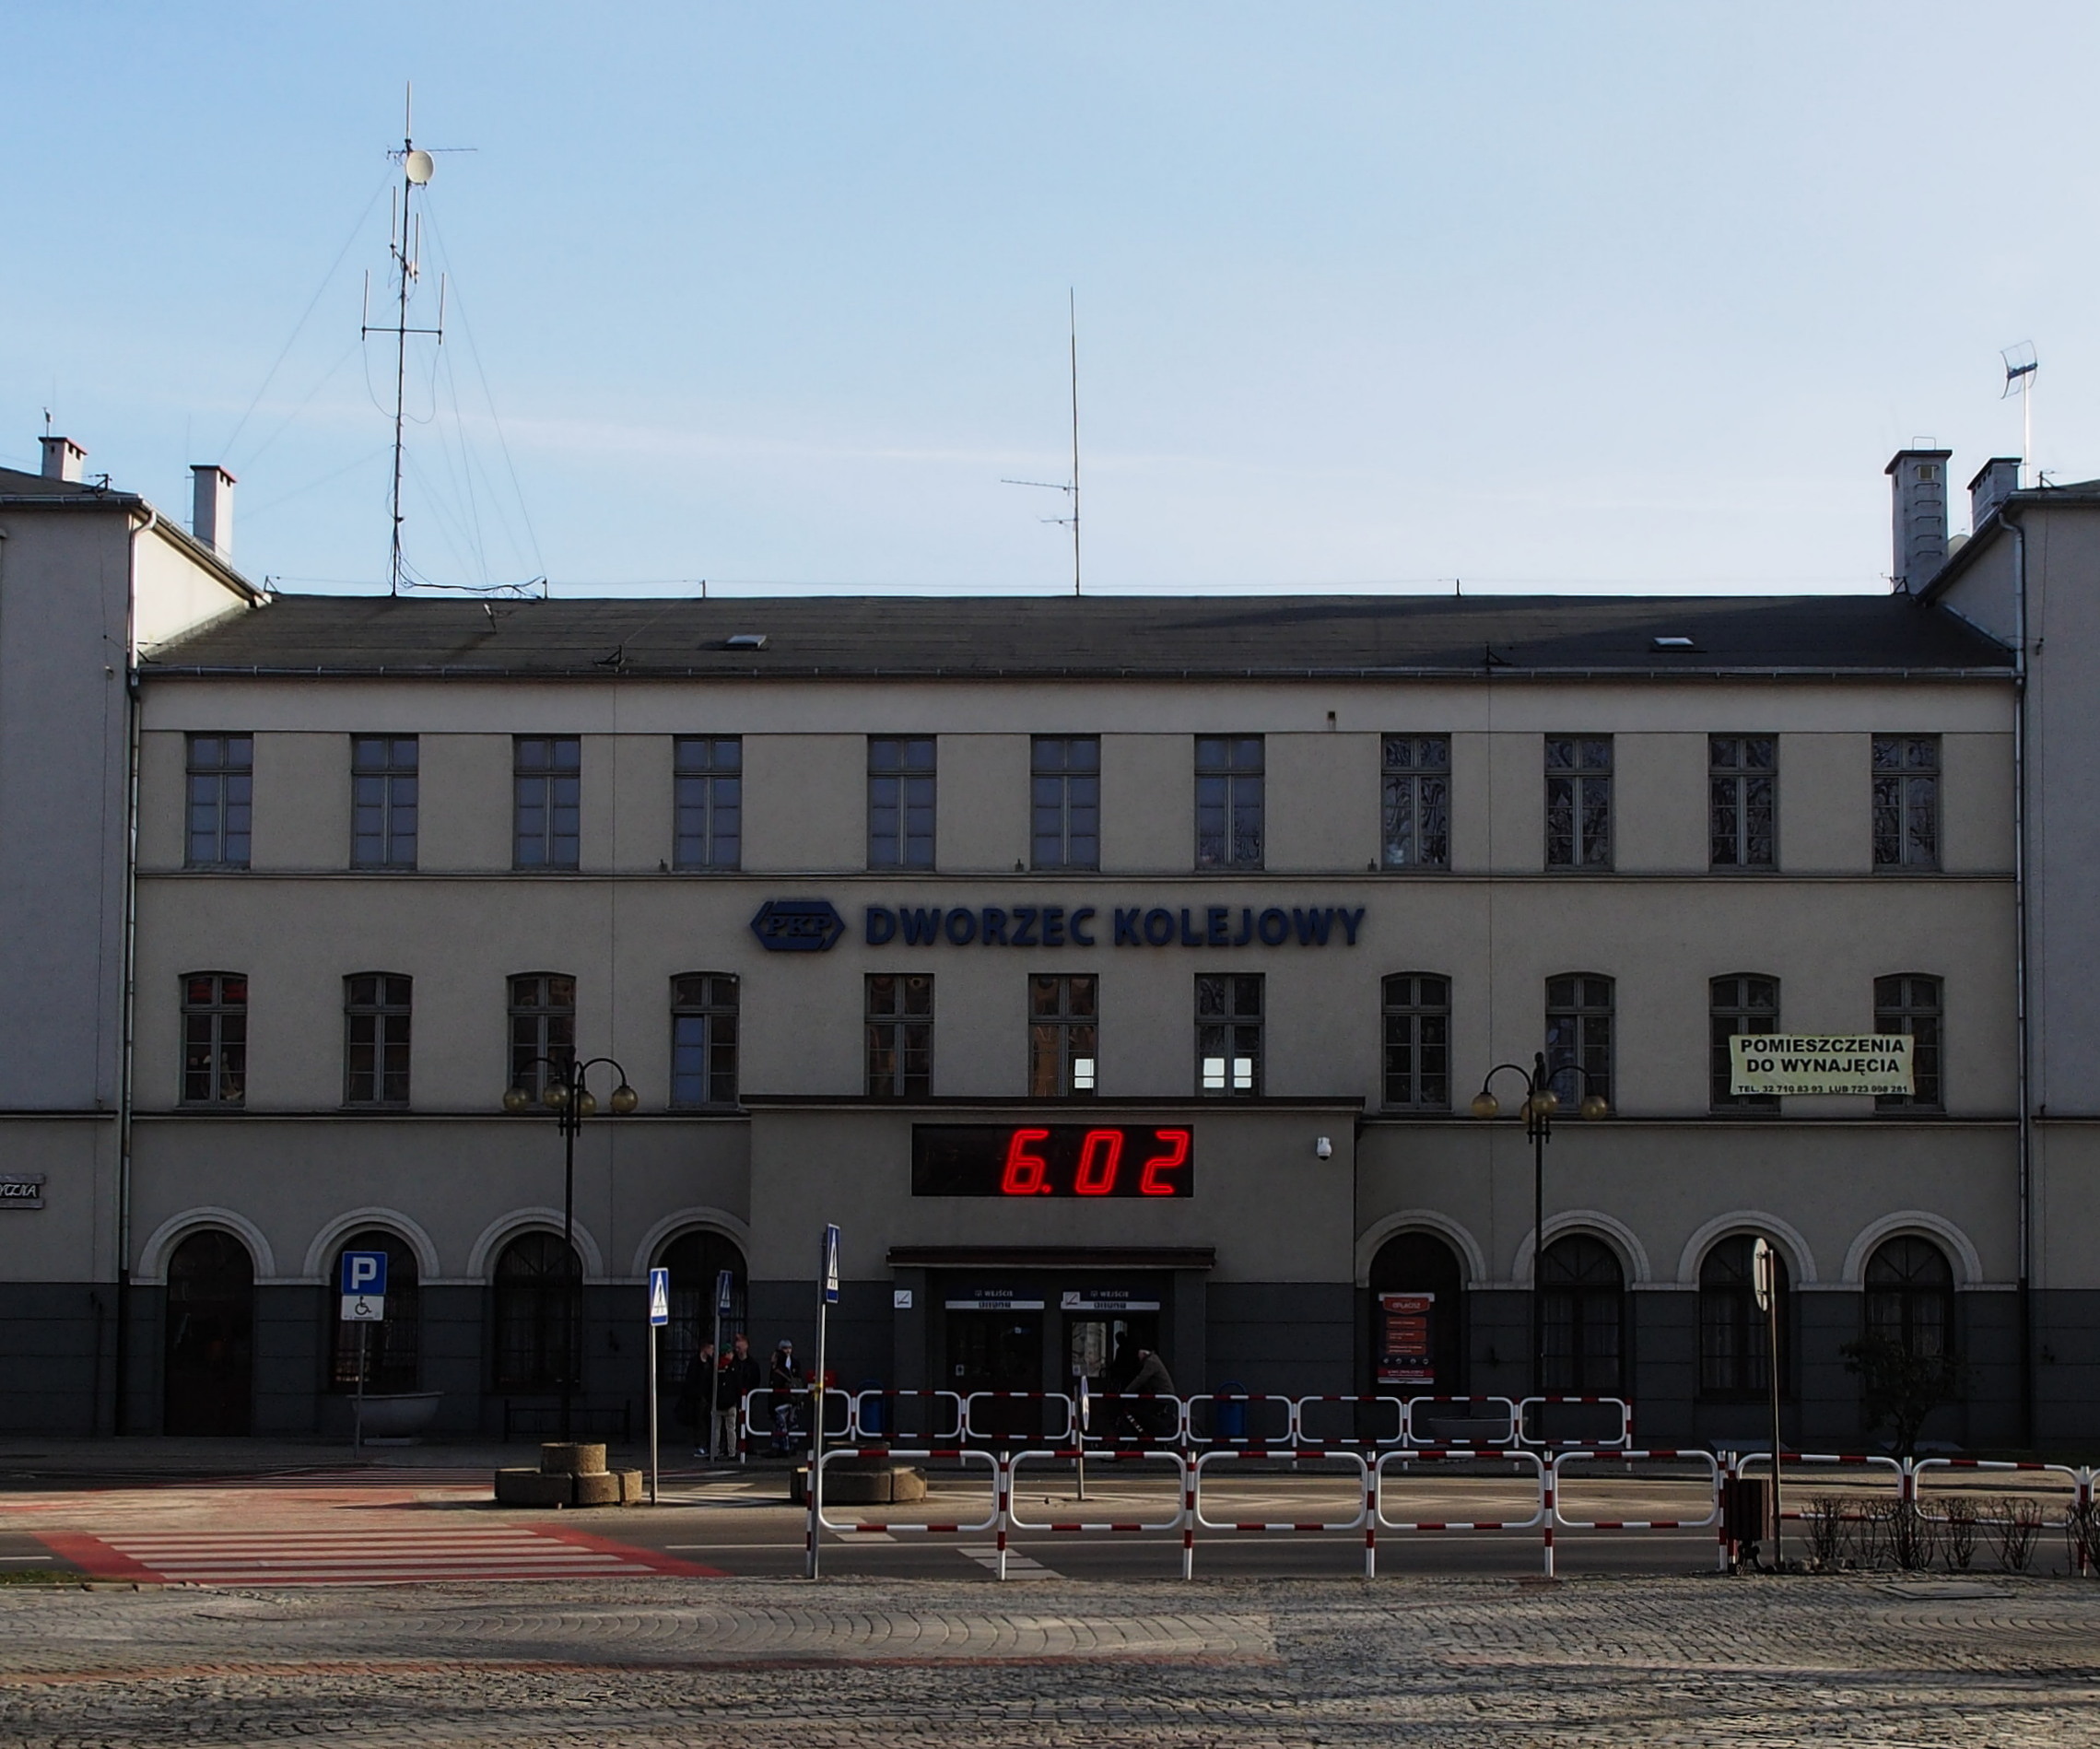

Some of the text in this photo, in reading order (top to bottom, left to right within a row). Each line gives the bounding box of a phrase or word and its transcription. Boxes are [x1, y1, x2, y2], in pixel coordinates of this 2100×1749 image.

[766, 915, 832, 936] PKP
[865, 907, 1367, 948] DWORZEC KOLEJOWY
[1741, 1039, 1905, 1052] POMIESZCZENIA
[1747, 1059, 1900, 1075] DO WYNAJĘCIA
[350, 1256, 378, 1290] P
